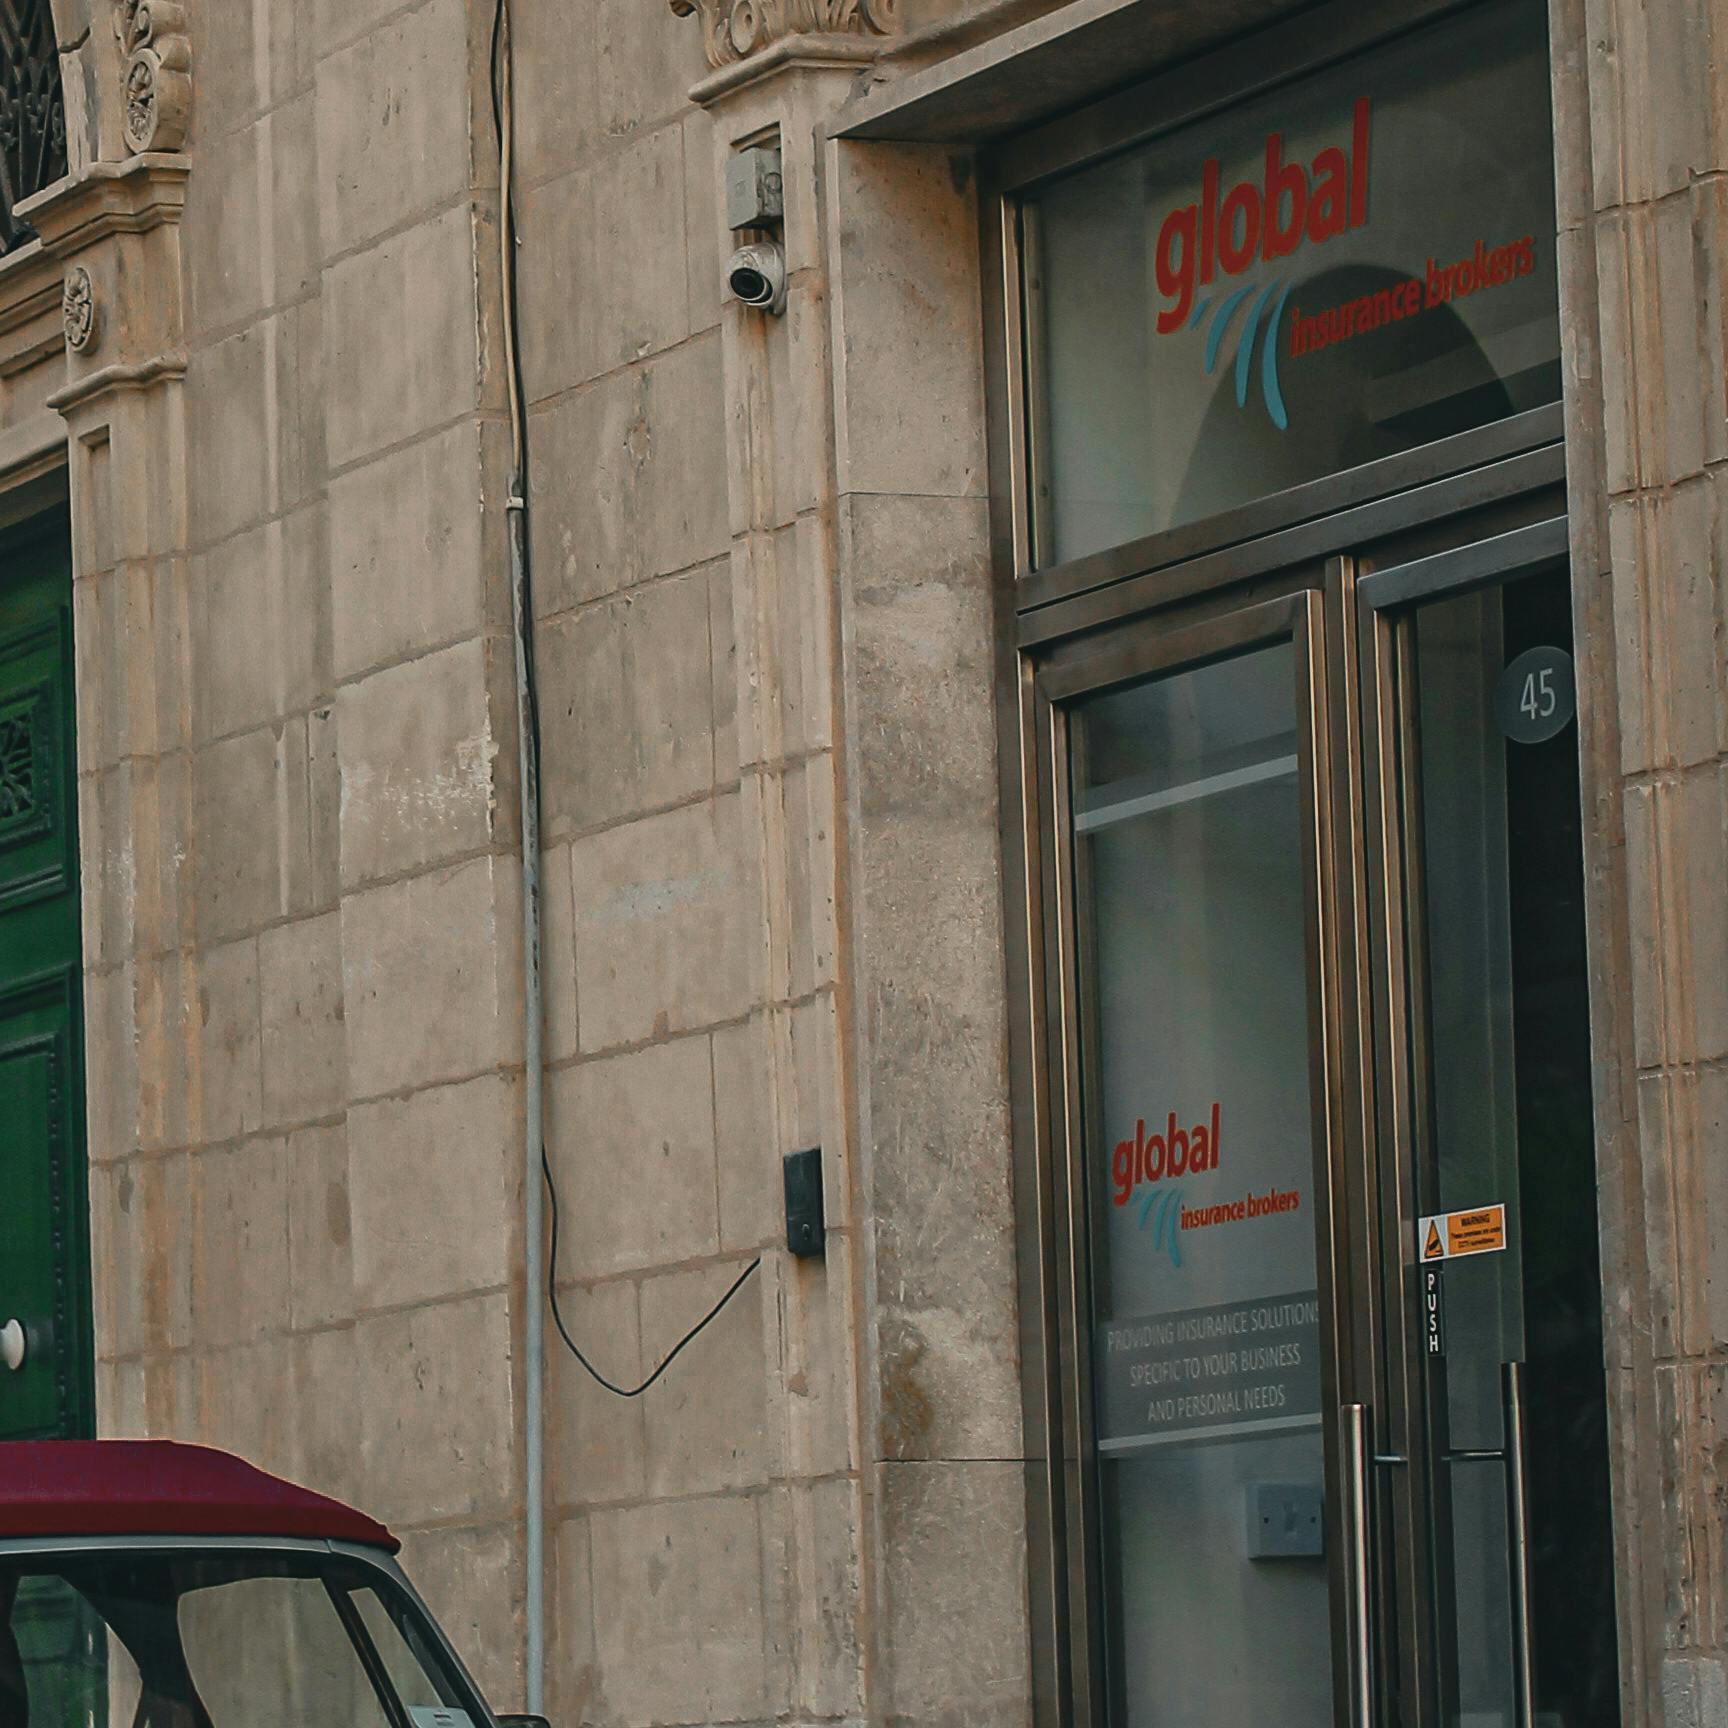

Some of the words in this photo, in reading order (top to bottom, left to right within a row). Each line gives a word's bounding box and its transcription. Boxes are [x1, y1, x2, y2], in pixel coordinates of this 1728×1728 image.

[1155, 96, 1370, 335] global
[1290, 280, 1420, 359] insurance
[1424, 235, 1535, 310] brokers
[1520, 668, 1556, 720] 45
[1112, 1103, 1220, 1206] global
[1181, 1200, 1244, 1231] insurance
[1247, 1188, 1300, 1218] brokers
[1107, 1323, 1174, 1353] PROVIDING
[1176, 1311, 1248, 1343] INSURANCE
[1427, 1273, 1439, 1353] PUSH
[1130, 1366, 1182, 1387] SPECIFIC
[1184, 1357, 1201, 1378] TO
[1202, 1350, 1238, 1376] YOUR
[1240, 1343, 1302, 1372] BUSINESS
[1147, 1399, 1175, 1422] AND
[1177, 1391, 1241, 1418] PERSONAL
[1243, 1384, 1286, 1409] NEEDS
